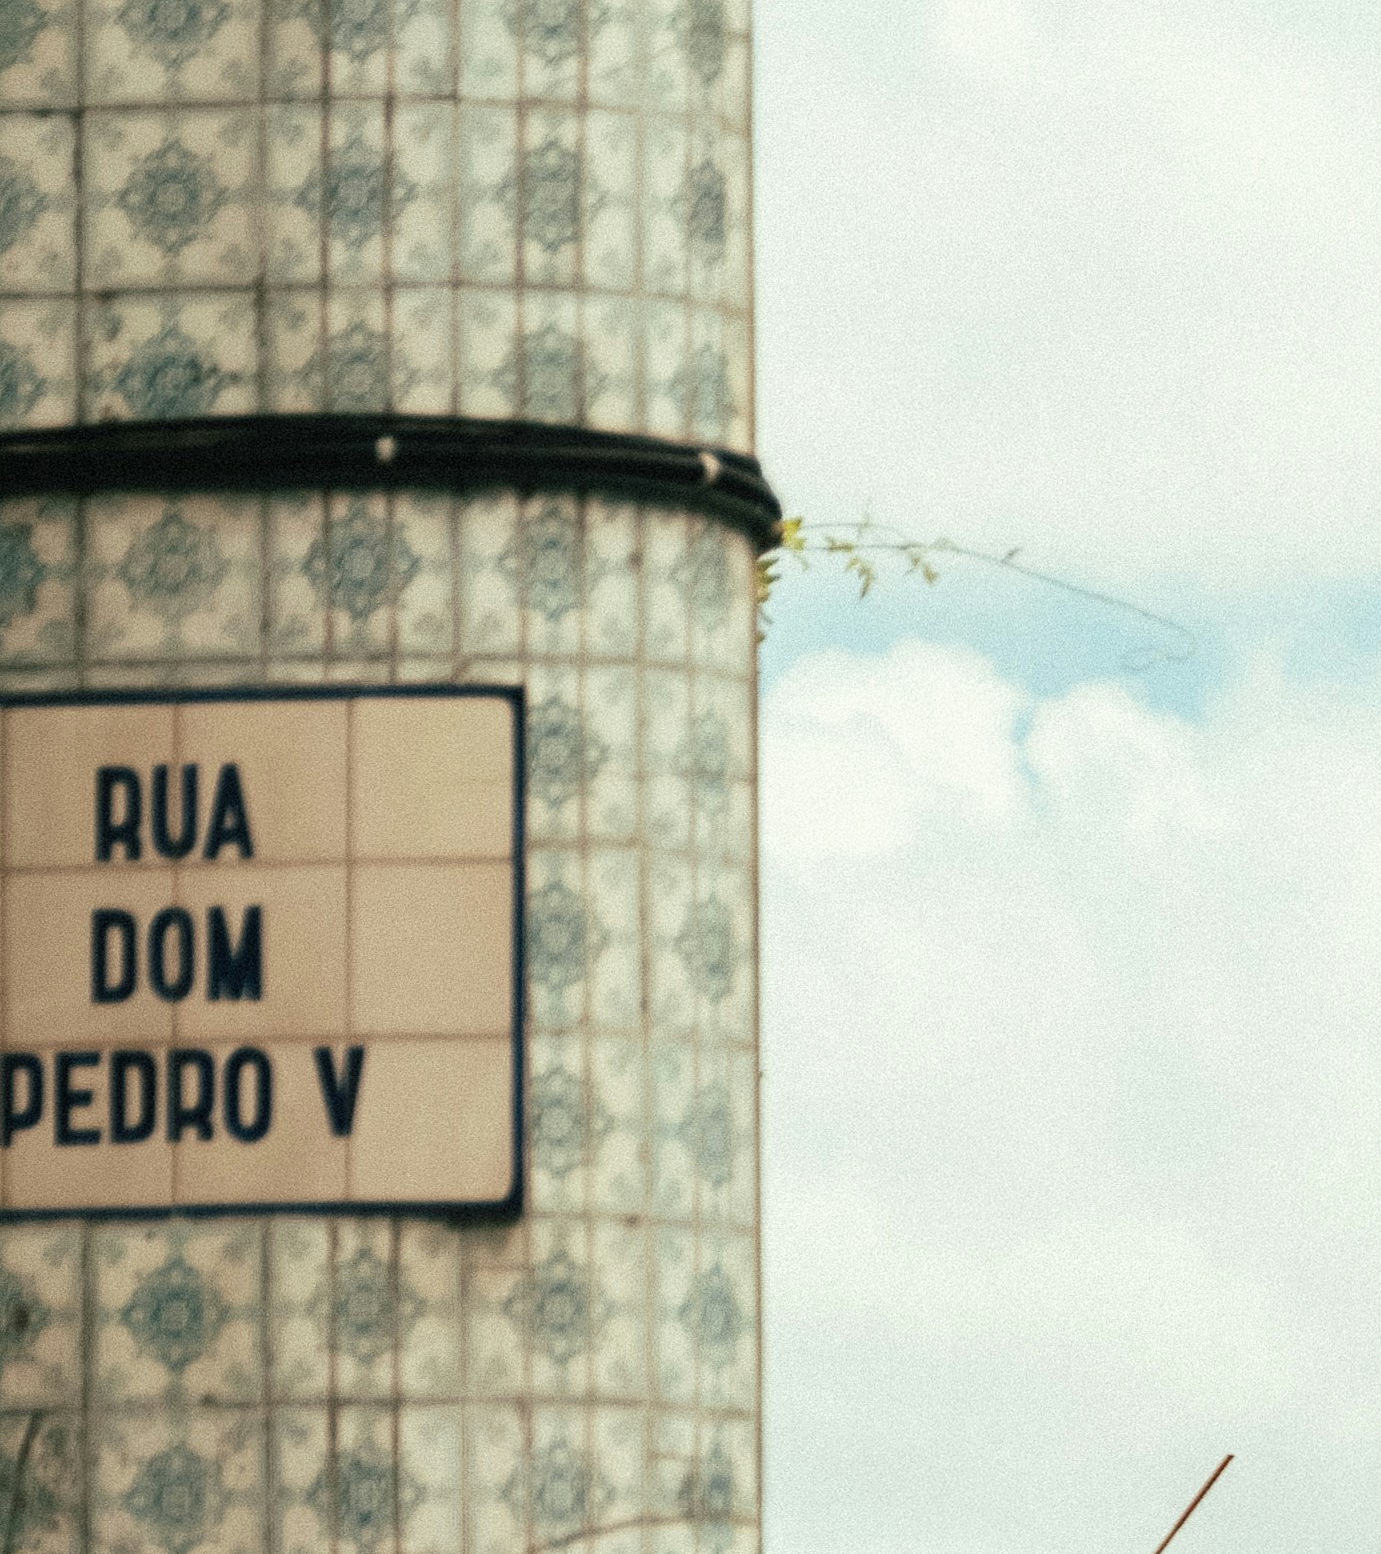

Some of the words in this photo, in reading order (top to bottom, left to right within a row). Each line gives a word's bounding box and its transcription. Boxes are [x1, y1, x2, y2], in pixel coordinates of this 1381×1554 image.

[96, 763, 254, 862] RUA
[90, 905, 262, 1003] DOM
[0, 1047, 273, 1147] PEDRO
[313, 1046, 365, 1137] V
